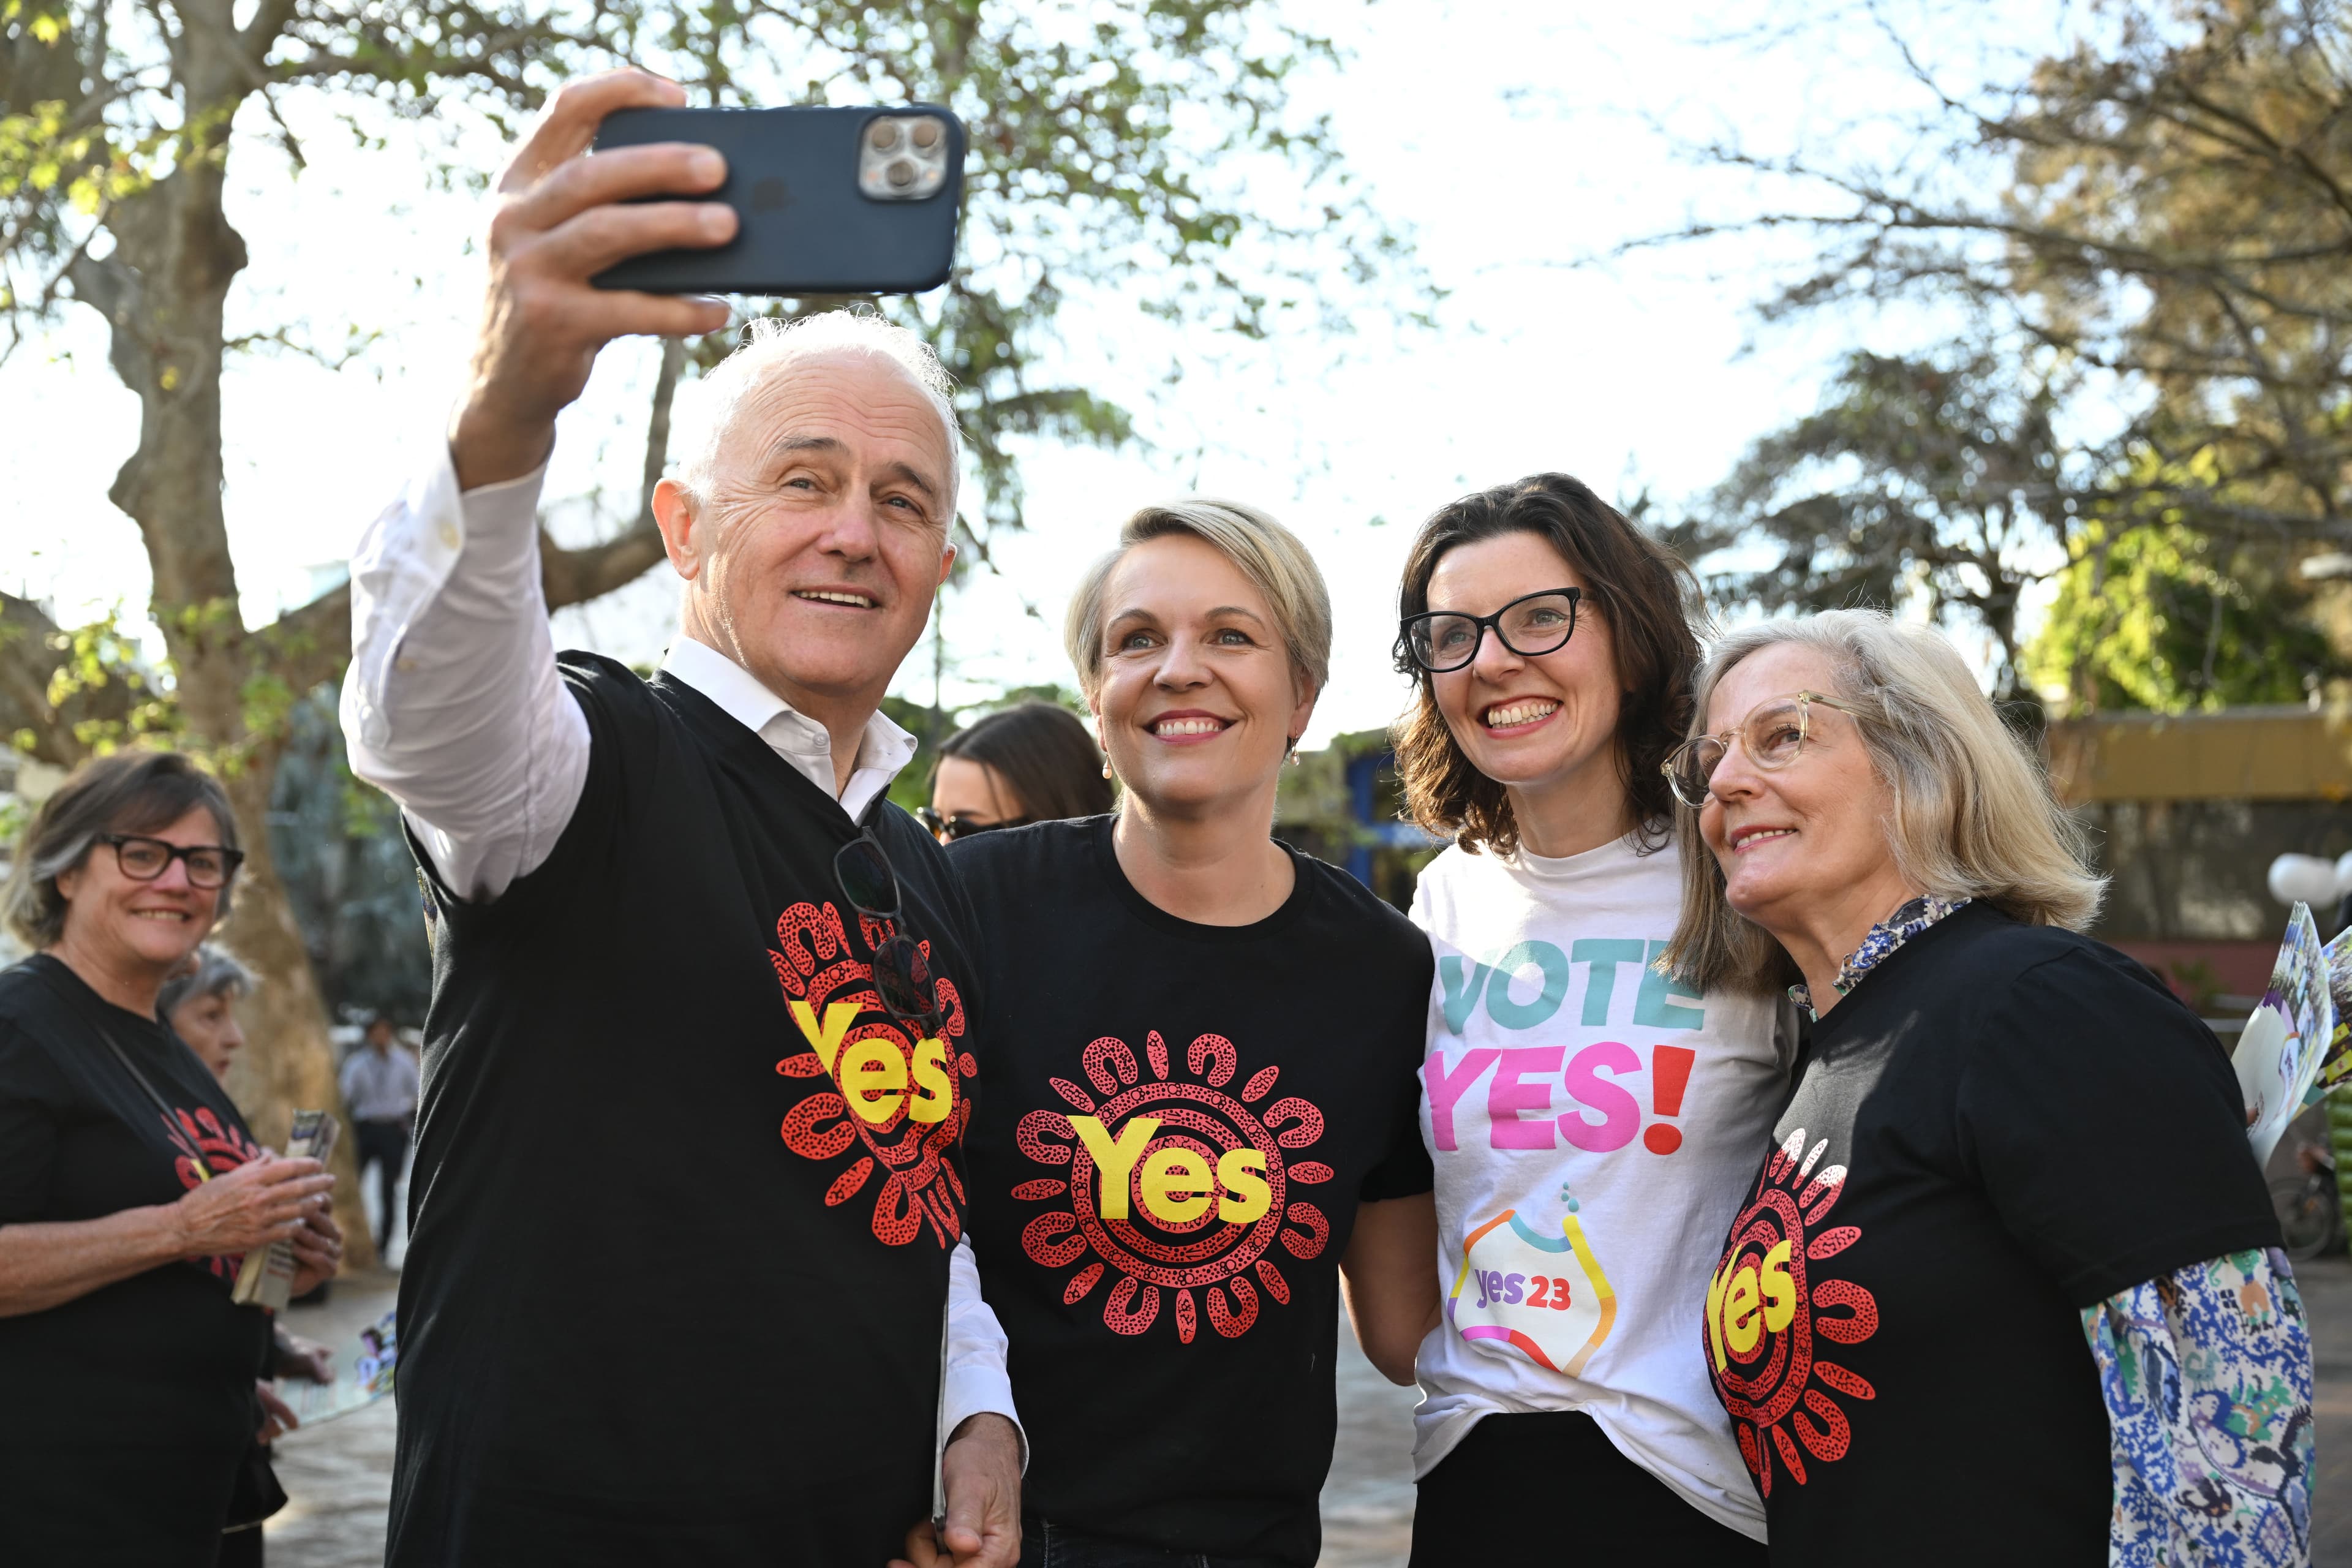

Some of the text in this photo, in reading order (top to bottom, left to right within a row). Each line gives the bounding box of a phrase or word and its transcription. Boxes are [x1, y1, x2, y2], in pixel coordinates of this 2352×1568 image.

[1439, 938, 1705, 1035] VOTE
[790, 1000, 953, 1123] Yes
[1423, 1041, 1695, 1156] YES!
[1066, 1115, 1272, 1224] Yes
